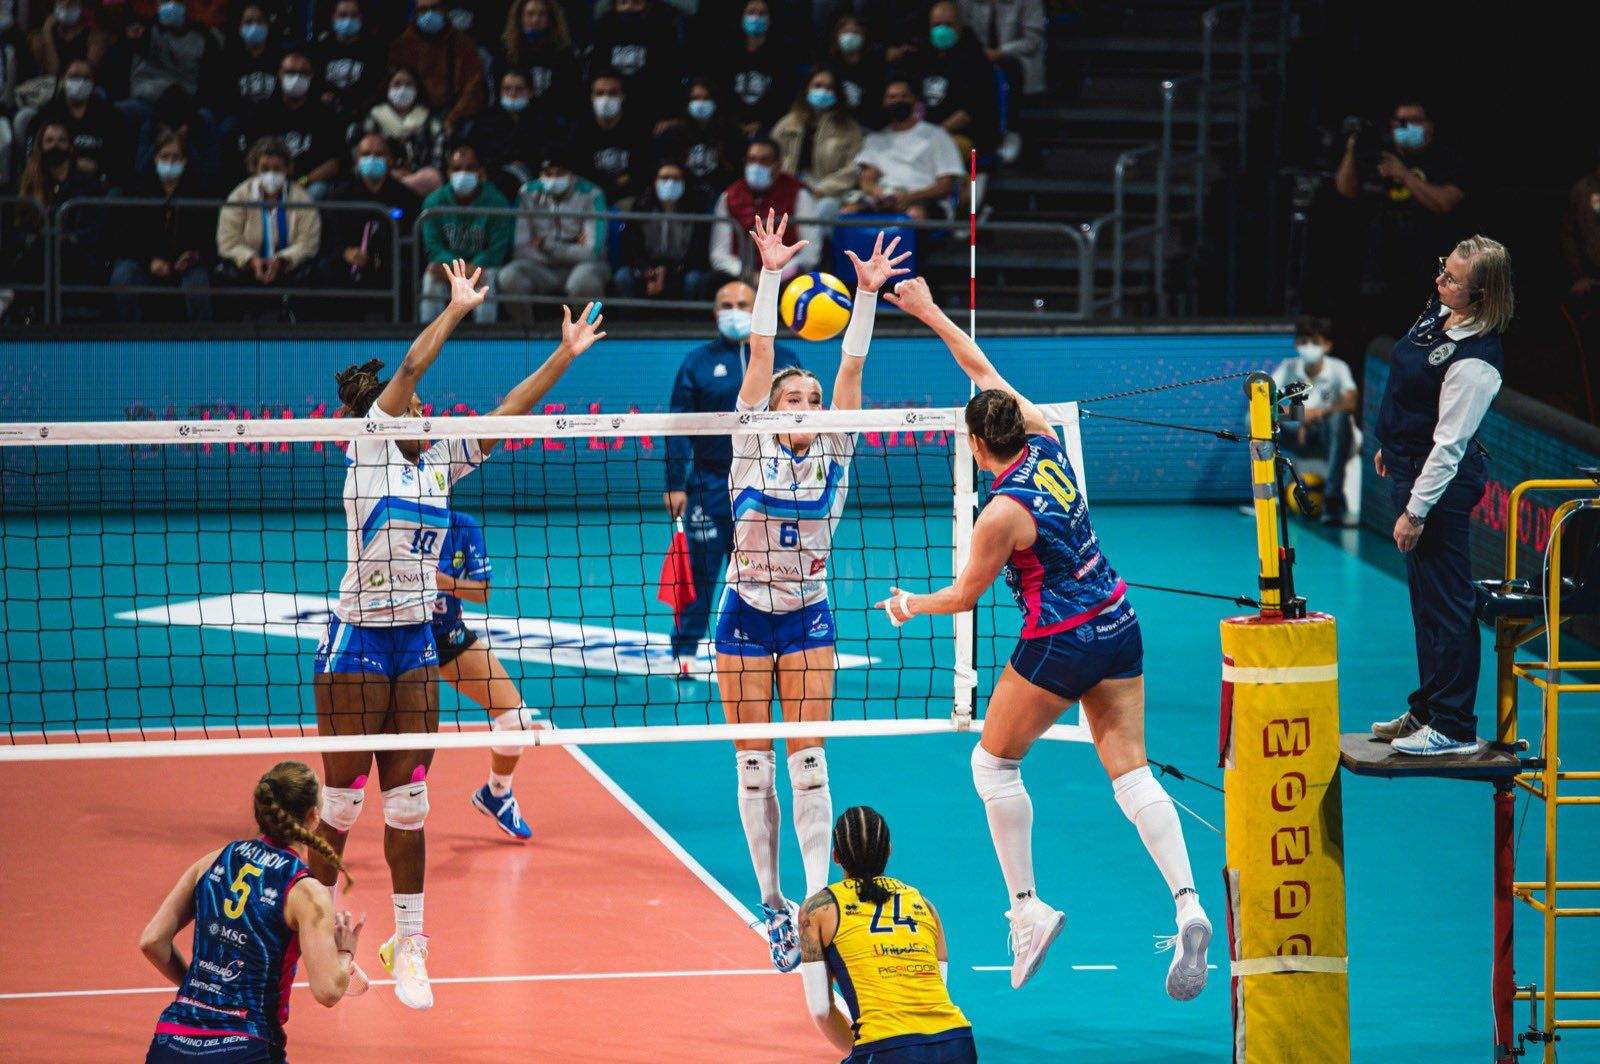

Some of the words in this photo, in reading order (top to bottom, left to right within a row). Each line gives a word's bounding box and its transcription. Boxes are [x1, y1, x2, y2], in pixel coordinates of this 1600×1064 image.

[1033, 459, 1076, 513] 10
[410, 529, 438, 554] 10
[779, 522, 798, 548] 6
[388, 571, 430, 584] SANAYA
[750, 560, 801, 575] SANAYA
[1262, 717, 1311, 962] MONDO
[235, 841, 289, 869] MALINOV
[223, 863, 263, 919] 5
[870, 893, 918, 934] 24
[221, 926, 248, 945] MSC
[204, 1038, 220, 1047] DEL
